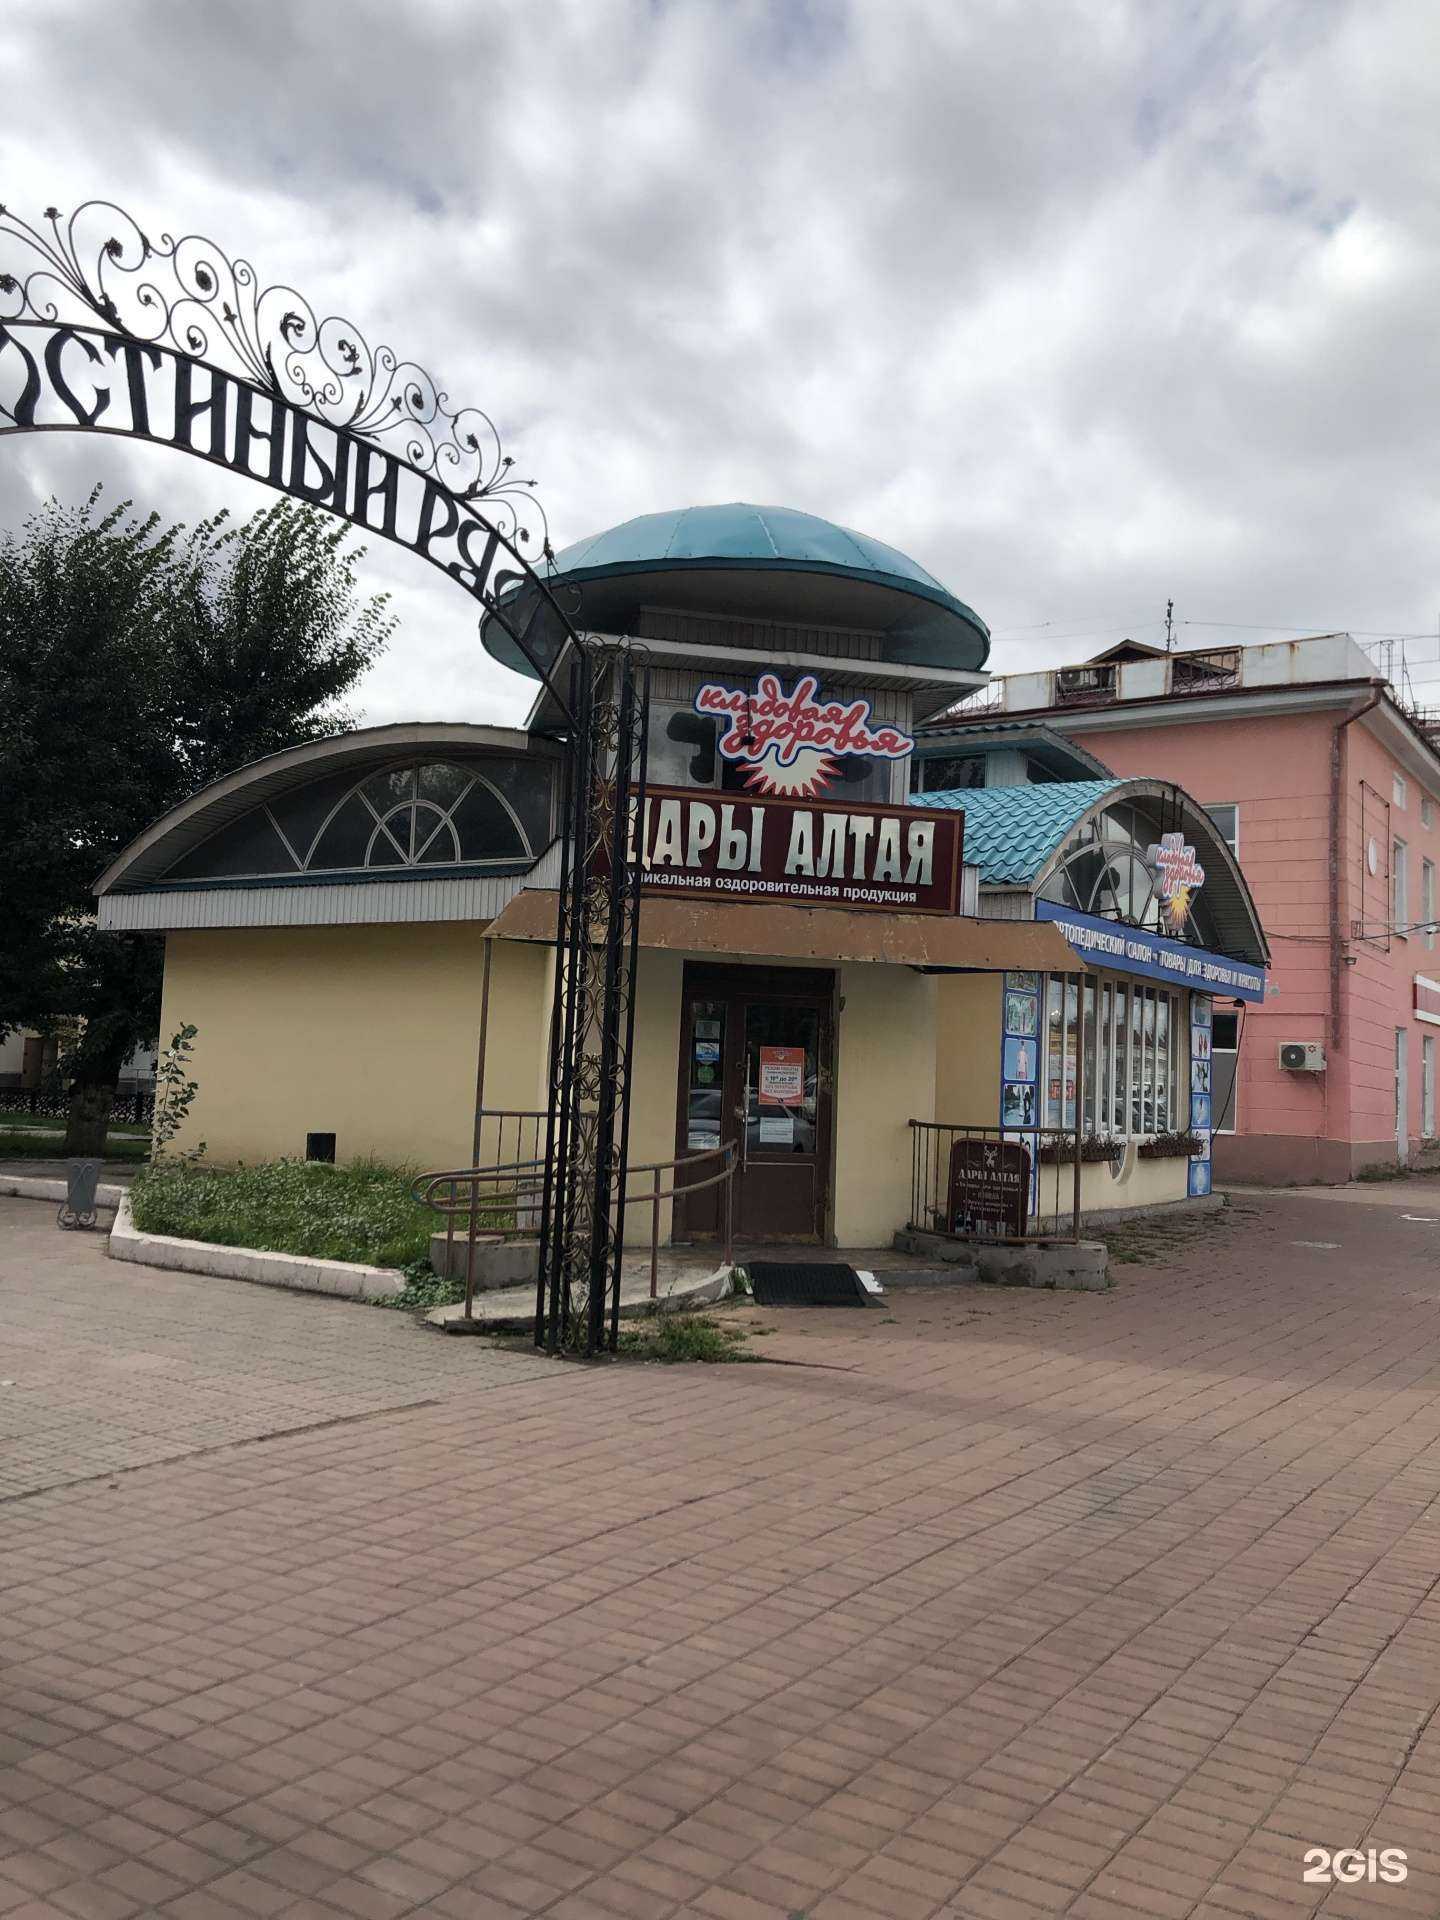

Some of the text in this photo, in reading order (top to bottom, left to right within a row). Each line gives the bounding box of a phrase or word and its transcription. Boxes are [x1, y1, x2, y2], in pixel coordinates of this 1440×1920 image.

[626, 796, 936, 886] ДАРЫ АЛТАЯ
[715, 877, 840, 897] оздоровительная
[843, 886, 917, 903] продукция
[1052, 920, 1126, 956] РТОПЕДИЧЕСКИЙ
[1126, 941, 1152, 963] САЛОН
[1159, 950, 1186, 973] ТОВАРЫ
